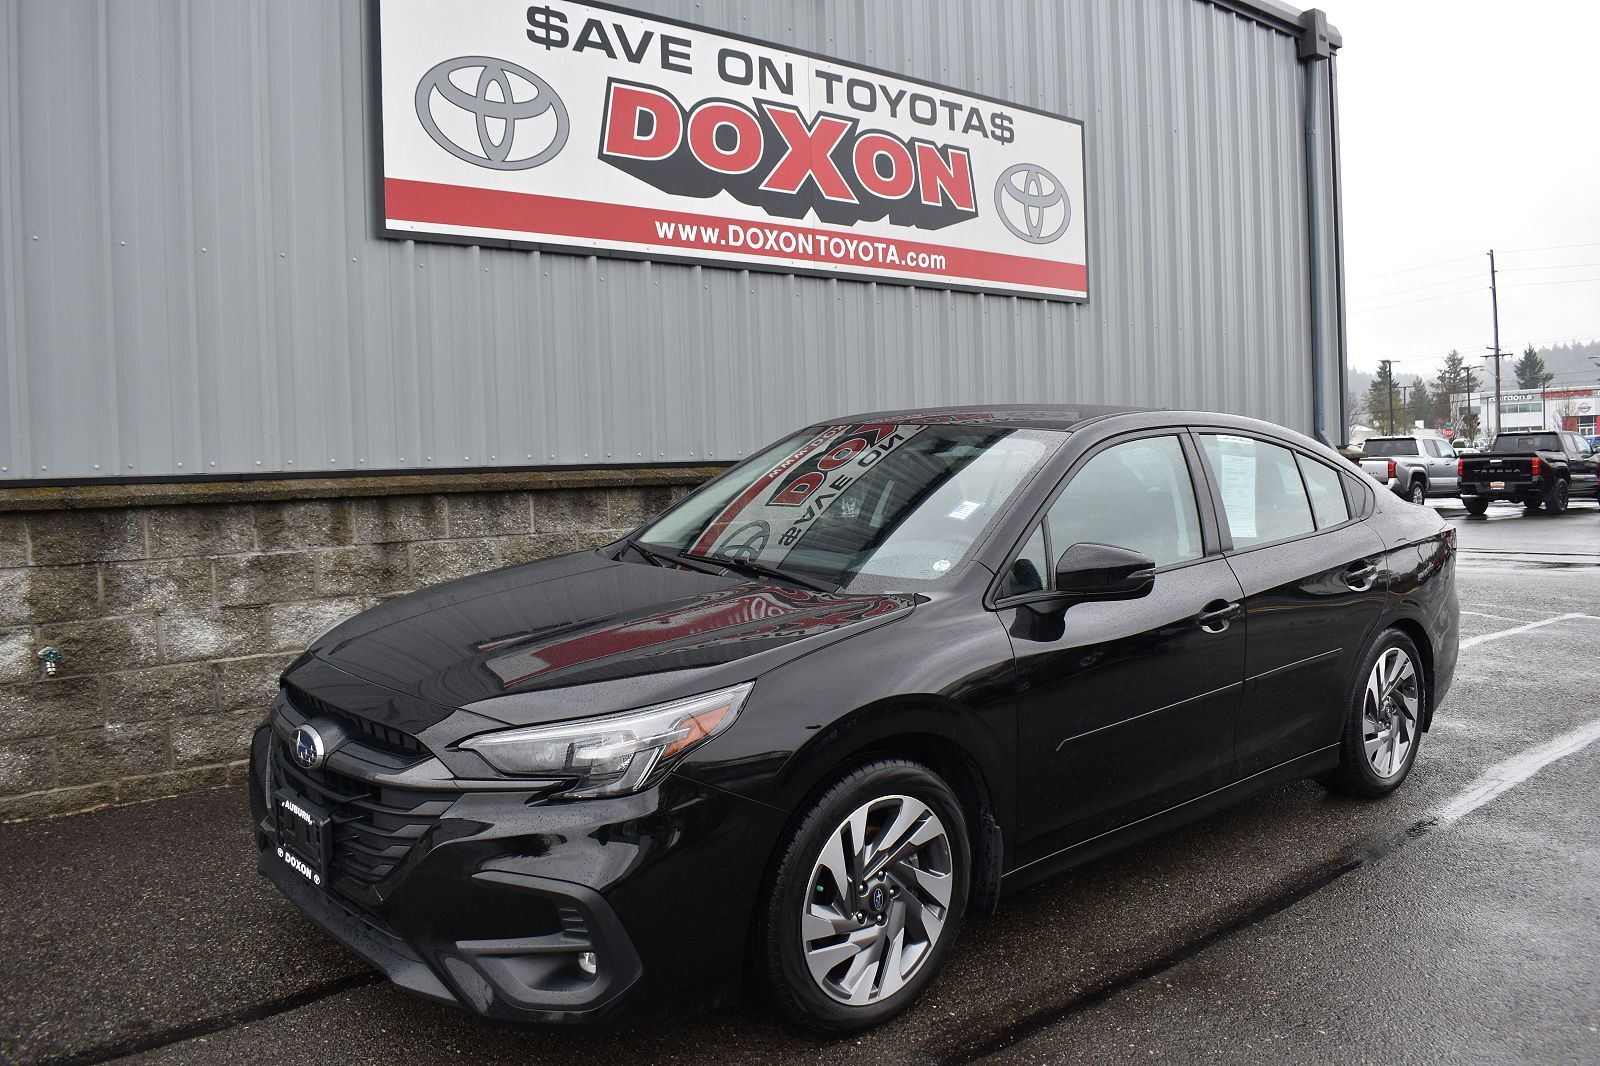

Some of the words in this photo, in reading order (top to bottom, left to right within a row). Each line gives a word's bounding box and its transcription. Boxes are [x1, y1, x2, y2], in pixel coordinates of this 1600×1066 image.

[526, 5, 693, 75] $AVE
[717, 48, 794, 96] ON
[815, 69, 1015, 145] TOYOTA$
[600, 78, 977, 218] DOXON
[654, 220, 947, 270] www.DOXONTOYOTA.com
[285, 851, 312, 880] DOXON
